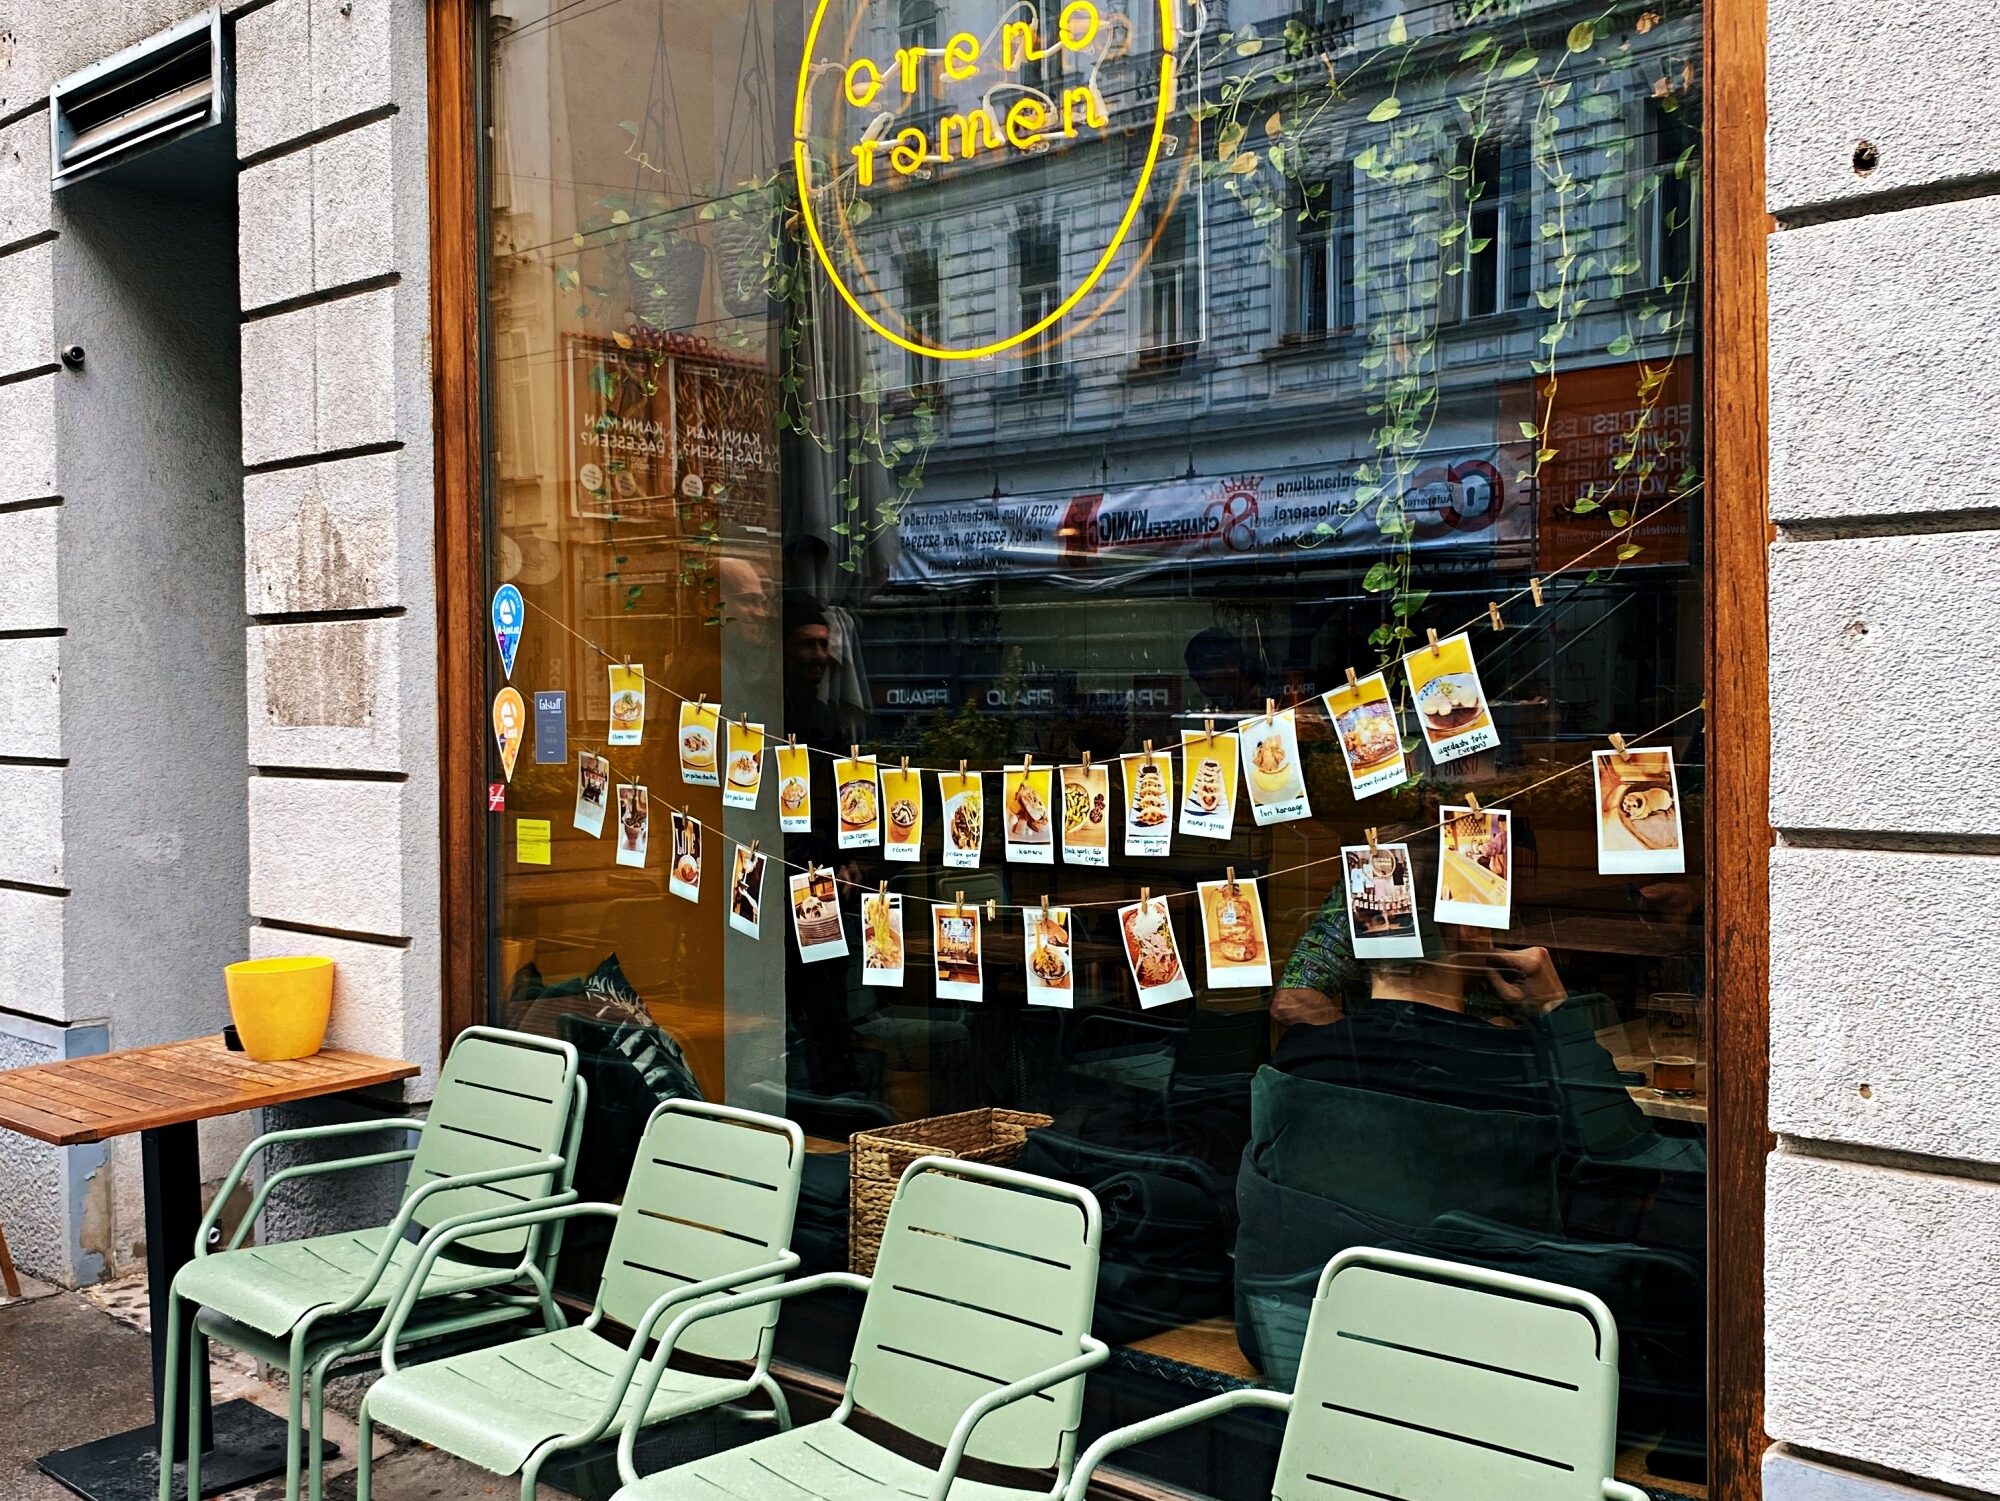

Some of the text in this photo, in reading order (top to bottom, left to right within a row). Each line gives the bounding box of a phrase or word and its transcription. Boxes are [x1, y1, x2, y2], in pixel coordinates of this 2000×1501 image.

[845, 0, 1100, 107] oreno
[851, 86, 1109, 187] ramen
[539, 698, 562, 710] falstaff
[1470, 733, 1488, 745] tofu
[1260, 804, 1303, 817] tori karaage
